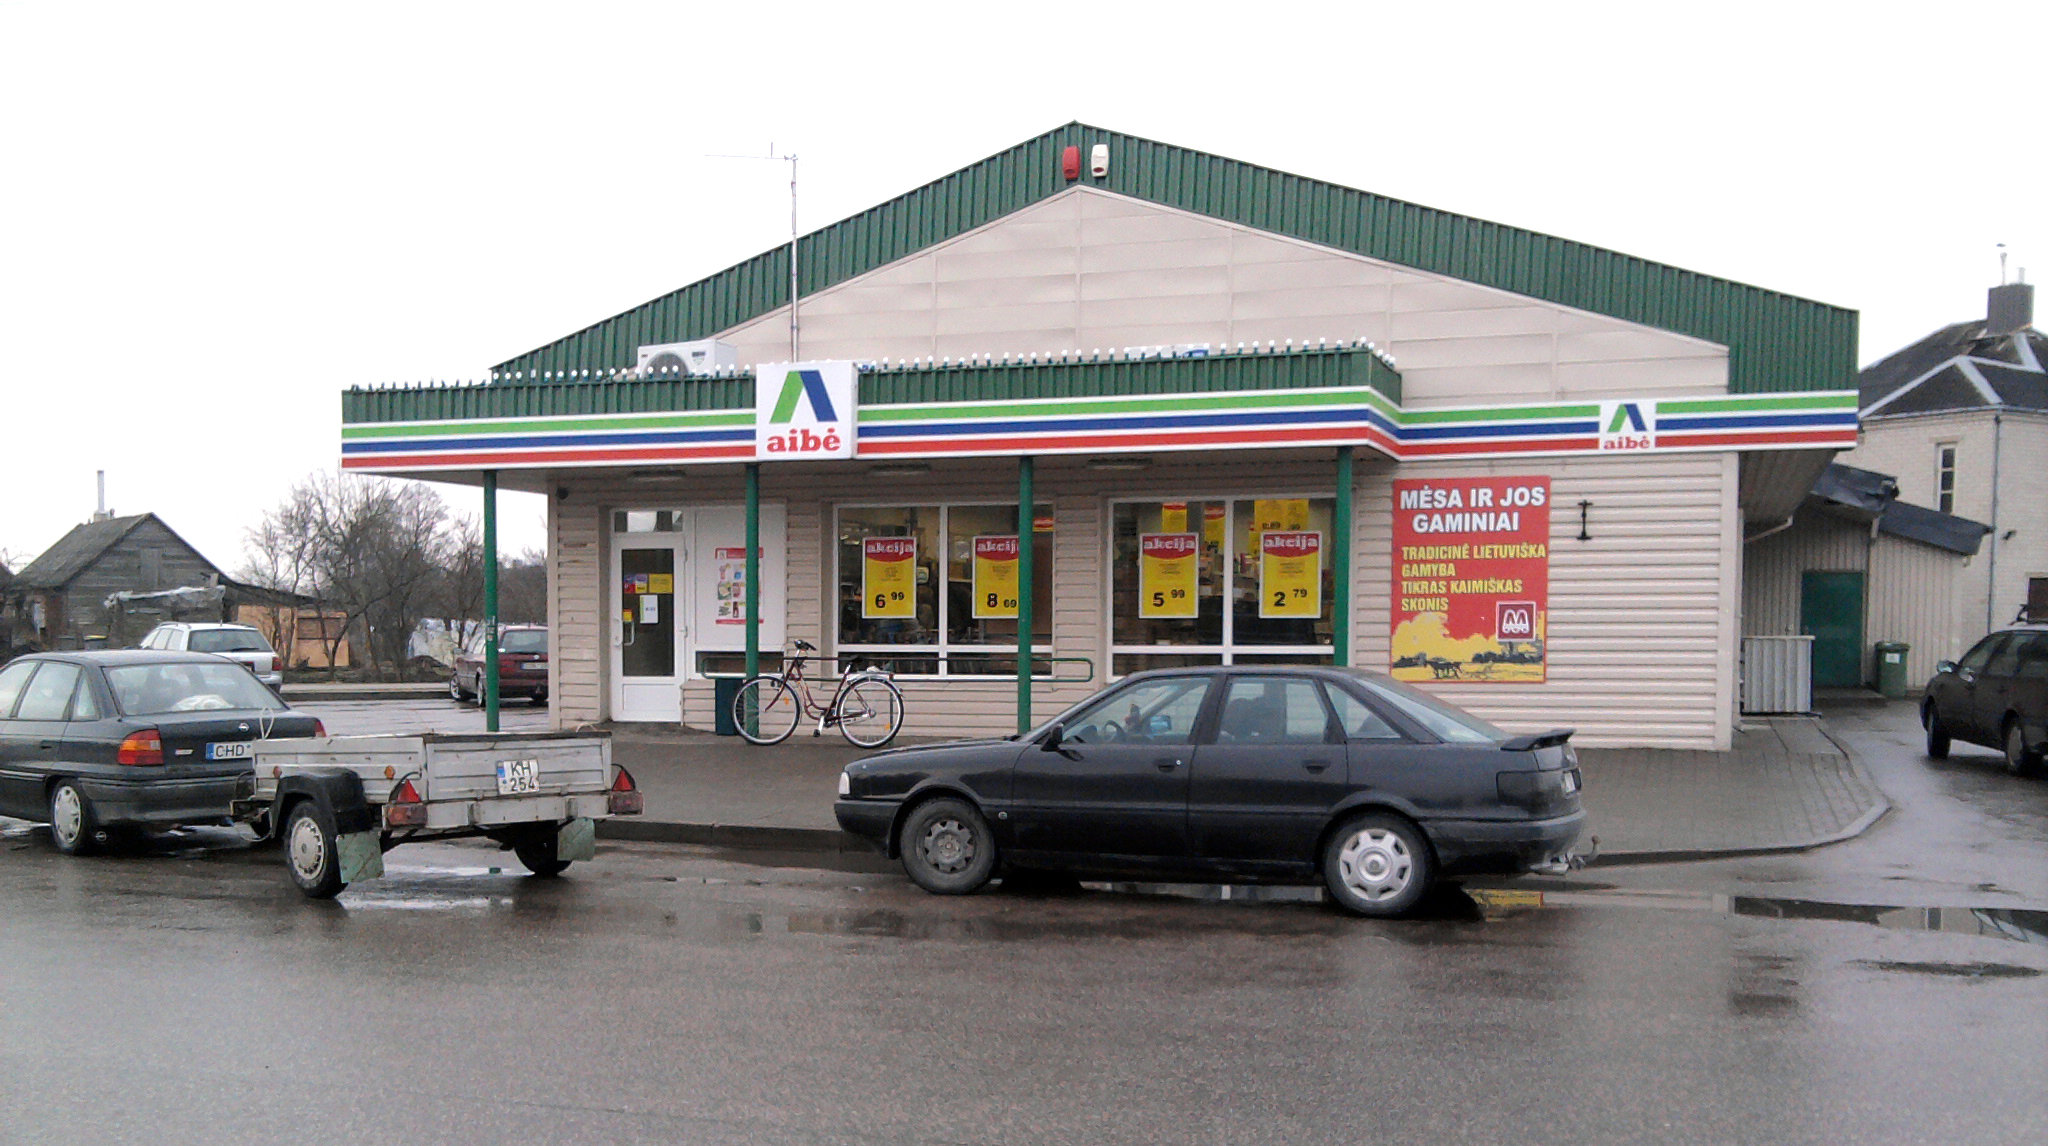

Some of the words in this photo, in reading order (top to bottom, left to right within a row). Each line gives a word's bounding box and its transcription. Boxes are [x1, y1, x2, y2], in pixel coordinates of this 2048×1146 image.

[767, 427, 841, 453] aibė
[1603, 435, 1650, 450] aibė
[1399, 485, 1463, 510] MĖSA
[1470, 487, 1494, 508] IR
[1499, 486, 1546, 508] JOS
[1412, 511, 1520, 533] GAMINIAI
[867, 542, 915, 554] akcija
[977, 540, 1019, 554] akcij
[1143, 537, 1196, 551] akcija
[1263, 536, 1318, 550] akcija
[1401, 543, 1470, 561] TRADICINĖ
[1472, 541, 1547, 560] LIETUVIŠKA
[1401, 563, 1456, 578] GAMYBA
[1401, 580, 1447, 595] TIKRAS
[1450, 577, 1523, 595] KAIMIŠKAS
[875, 593, 886, 608] 6
[987, 593, 998, 608] 8
[1153, 592, 1165, 607] 5
[1273, 591, 1286, 607] 2
[1401, 597, 1449, 612] SKONIS
[510, 760, 532, 776] KH
